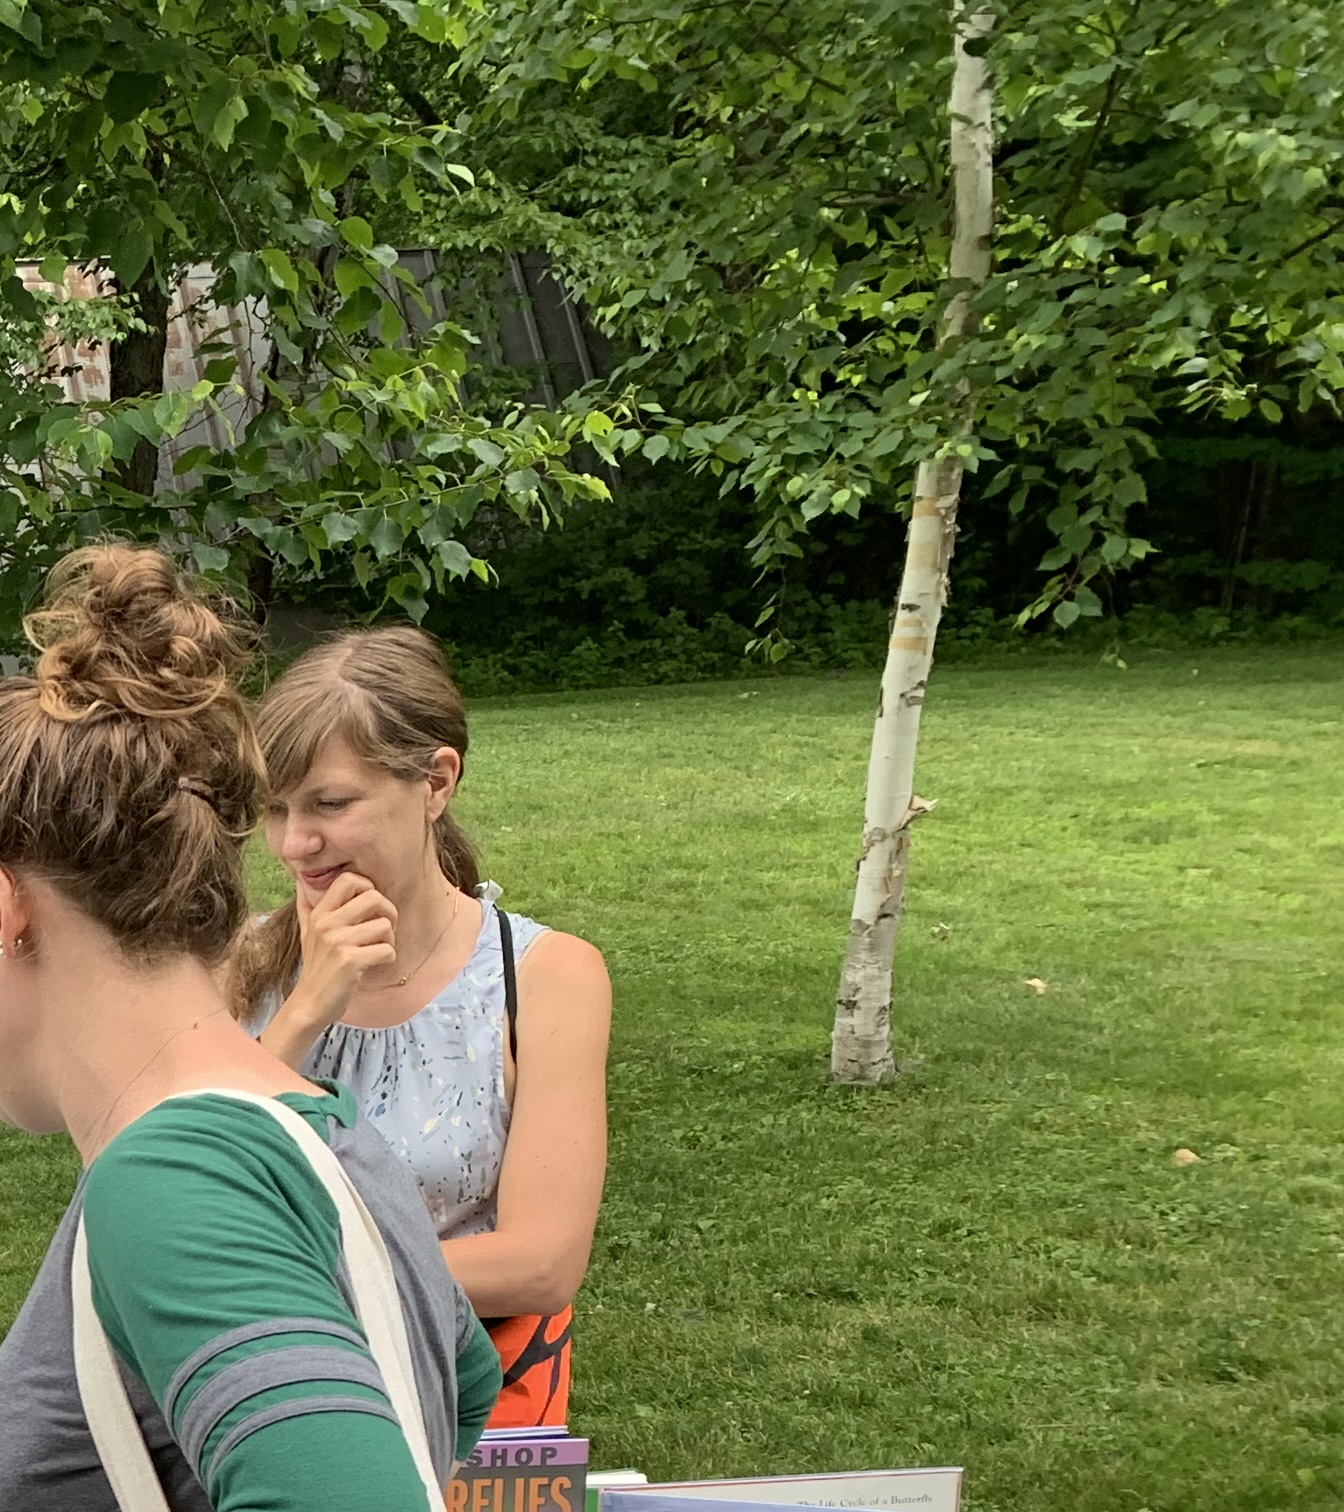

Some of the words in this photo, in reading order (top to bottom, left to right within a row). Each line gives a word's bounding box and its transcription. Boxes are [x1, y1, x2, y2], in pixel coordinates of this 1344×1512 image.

[466, 1447, 558, 1467] SHOP
[840, 1498, 866, 1508] Cycle
[869, 1496, 881, 1506] of
[891, 1494, 933, 1505] Butterfly
